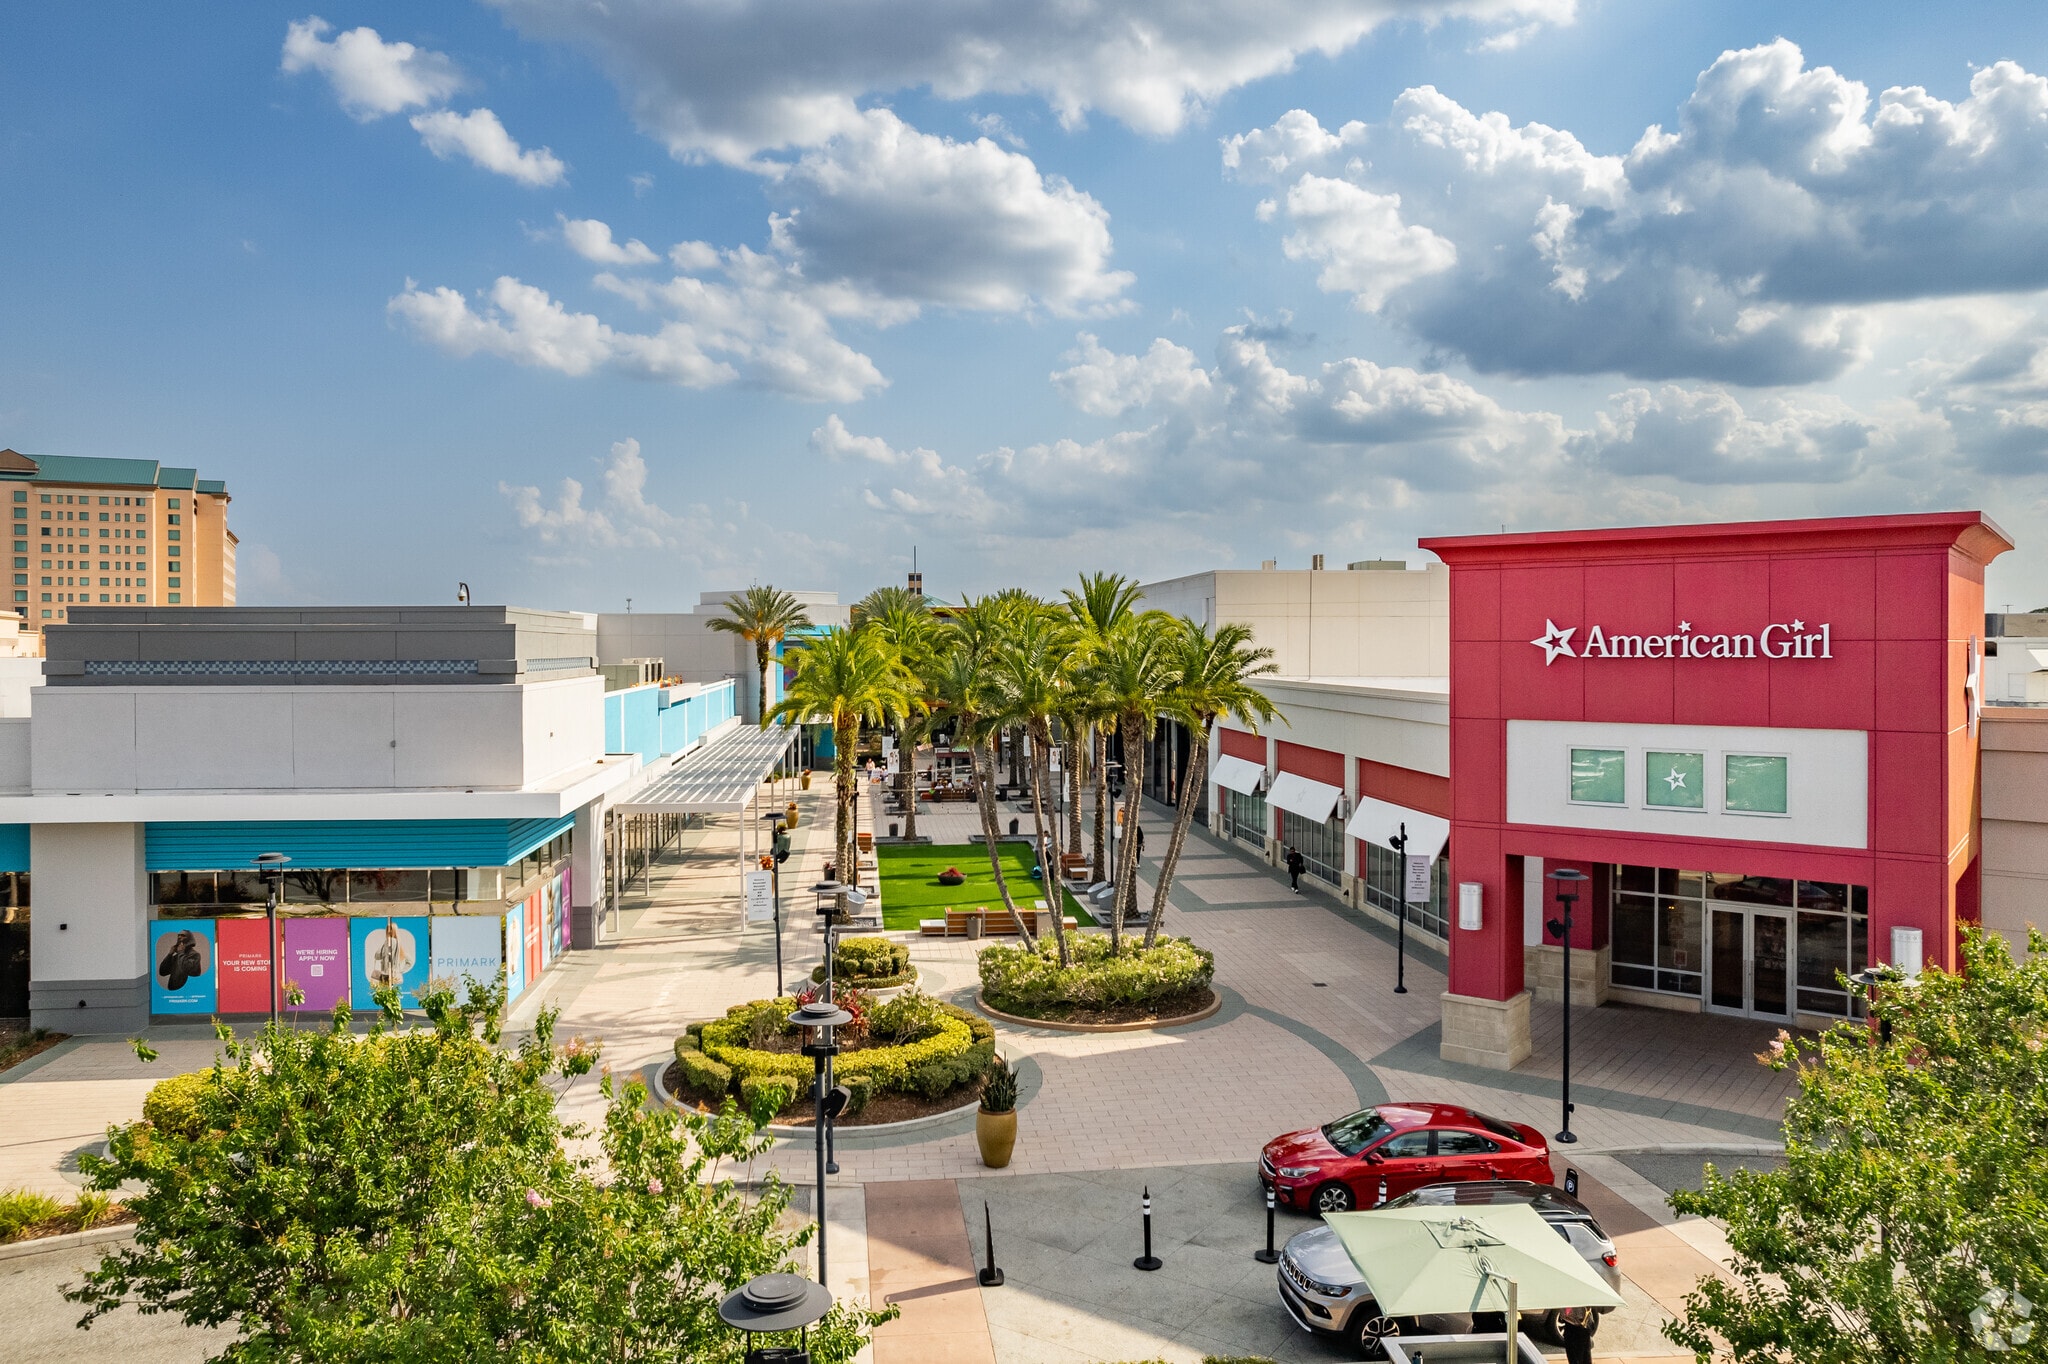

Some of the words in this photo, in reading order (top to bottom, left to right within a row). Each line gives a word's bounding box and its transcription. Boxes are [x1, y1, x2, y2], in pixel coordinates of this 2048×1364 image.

[1580, 620, 1757, 659] American
[1760, 618, 1833, 659] Girl
[437, 957, 497, 967] PRIMARK
